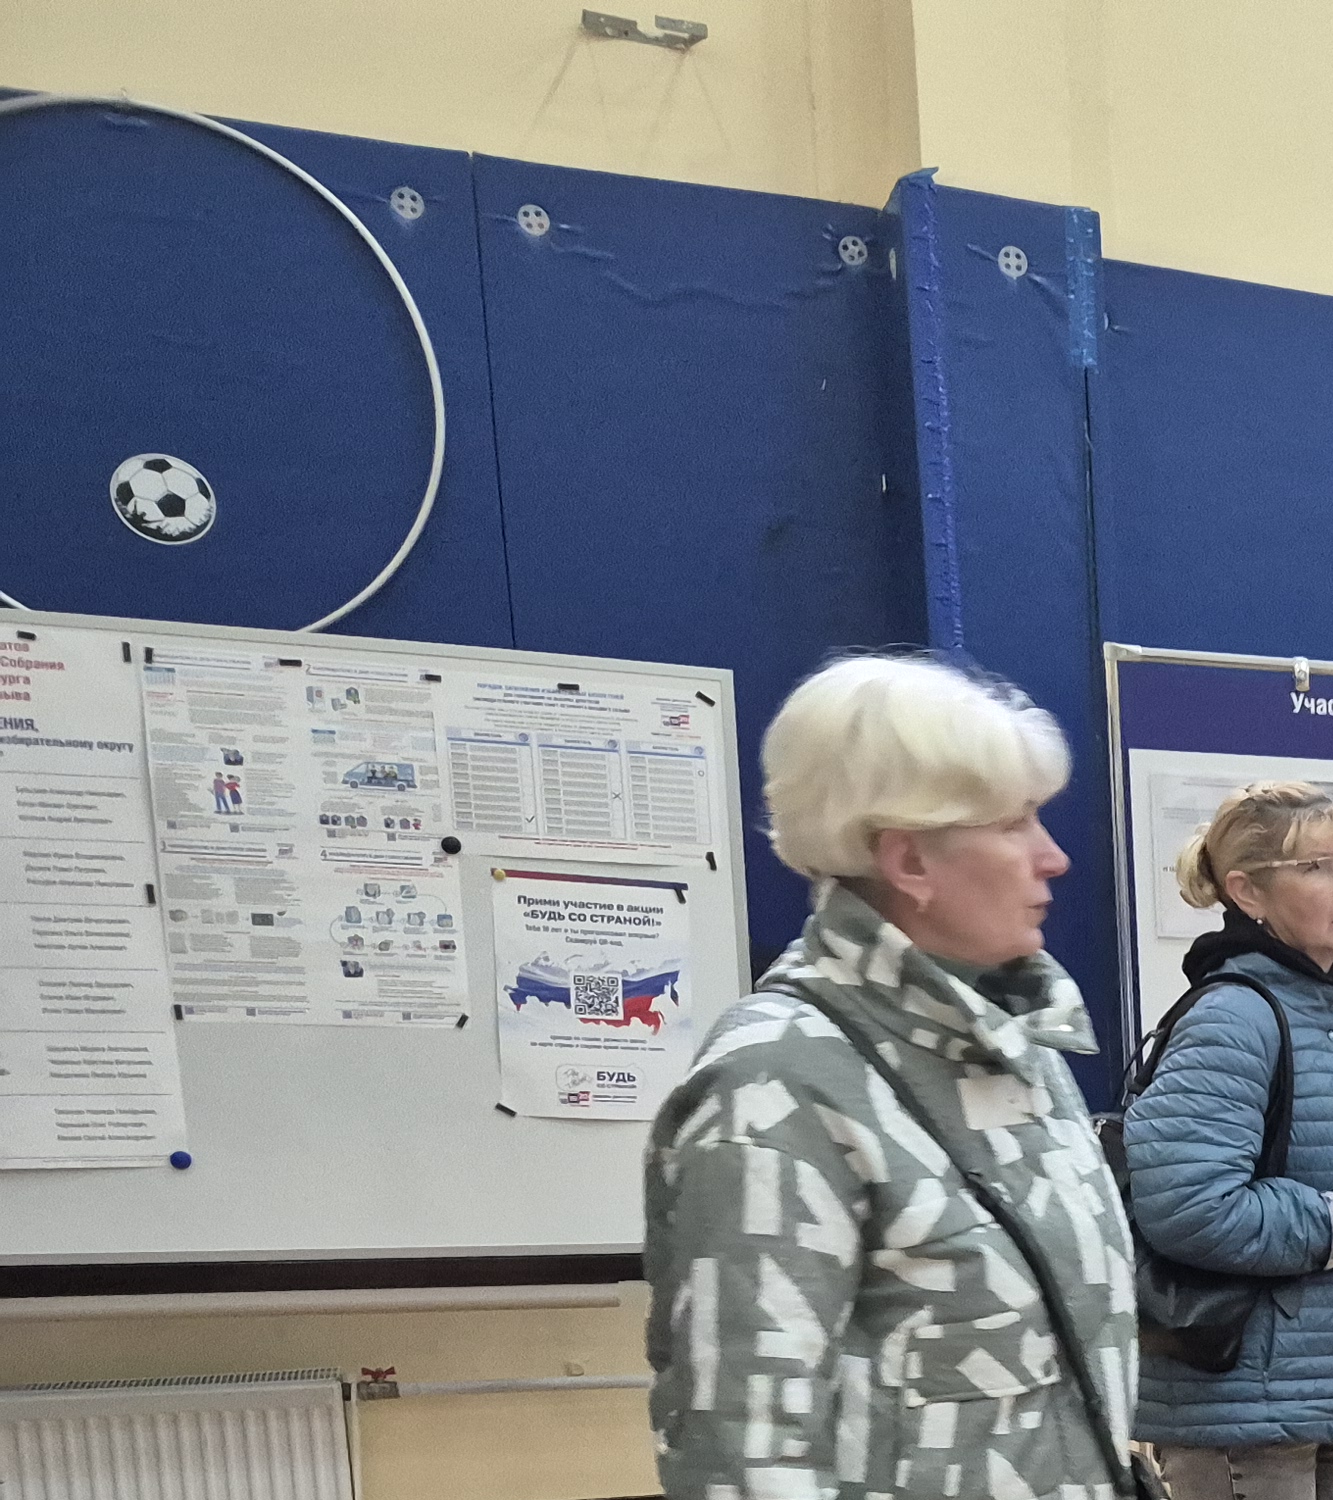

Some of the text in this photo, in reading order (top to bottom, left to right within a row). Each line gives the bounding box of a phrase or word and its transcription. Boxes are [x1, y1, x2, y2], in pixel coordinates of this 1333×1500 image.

[0, 656, 65, 670] Собрания
[0, 691, 31, 701] ыва
[97, 741, 134, 752] округу
[517, 895, 664, 915] Прими участие в акции
[523, 909, 662, 927] «БУДЬ СО СТРАНОЙ!»
[597, 1071, 636, 1083] БУДЬ
